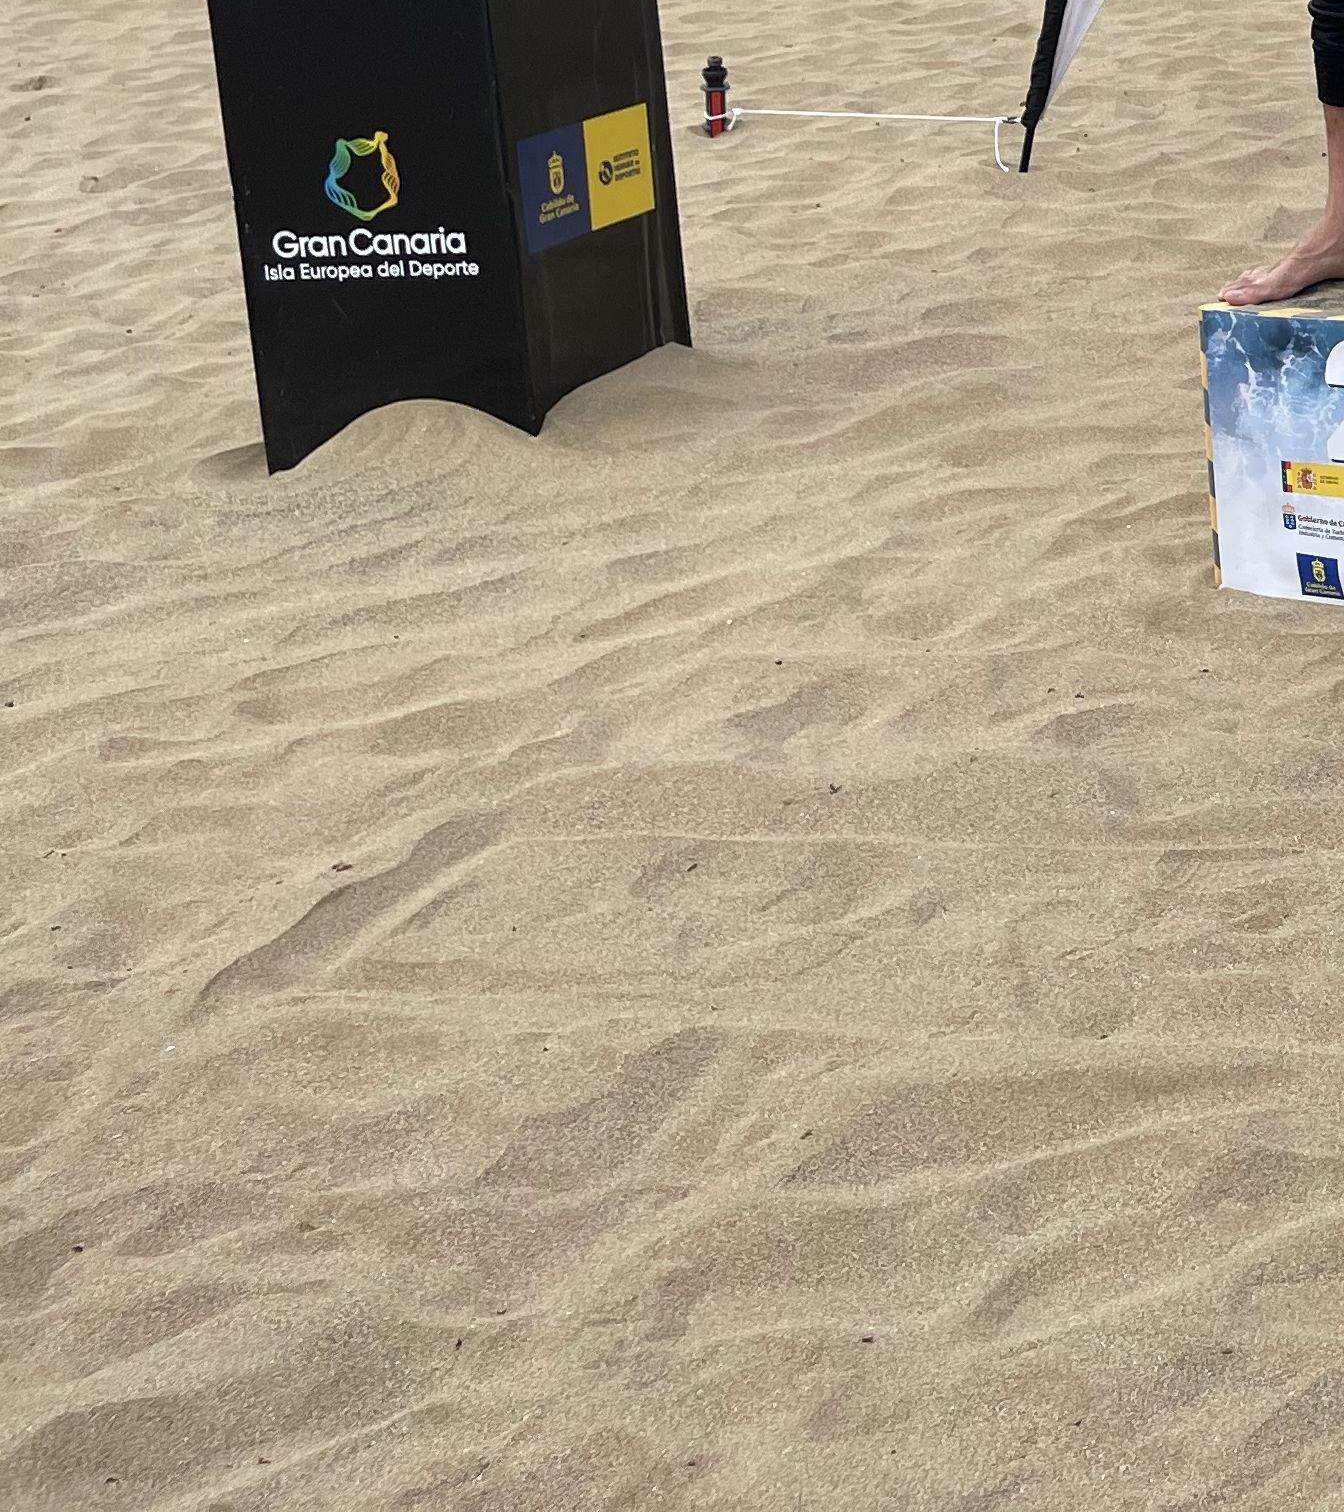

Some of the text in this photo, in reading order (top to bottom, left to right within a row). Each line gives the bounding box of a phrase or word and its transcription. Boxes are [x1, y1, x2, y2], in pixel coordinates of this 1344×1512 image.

[264, 259, 480, 281] Isla Europea del Deporte
